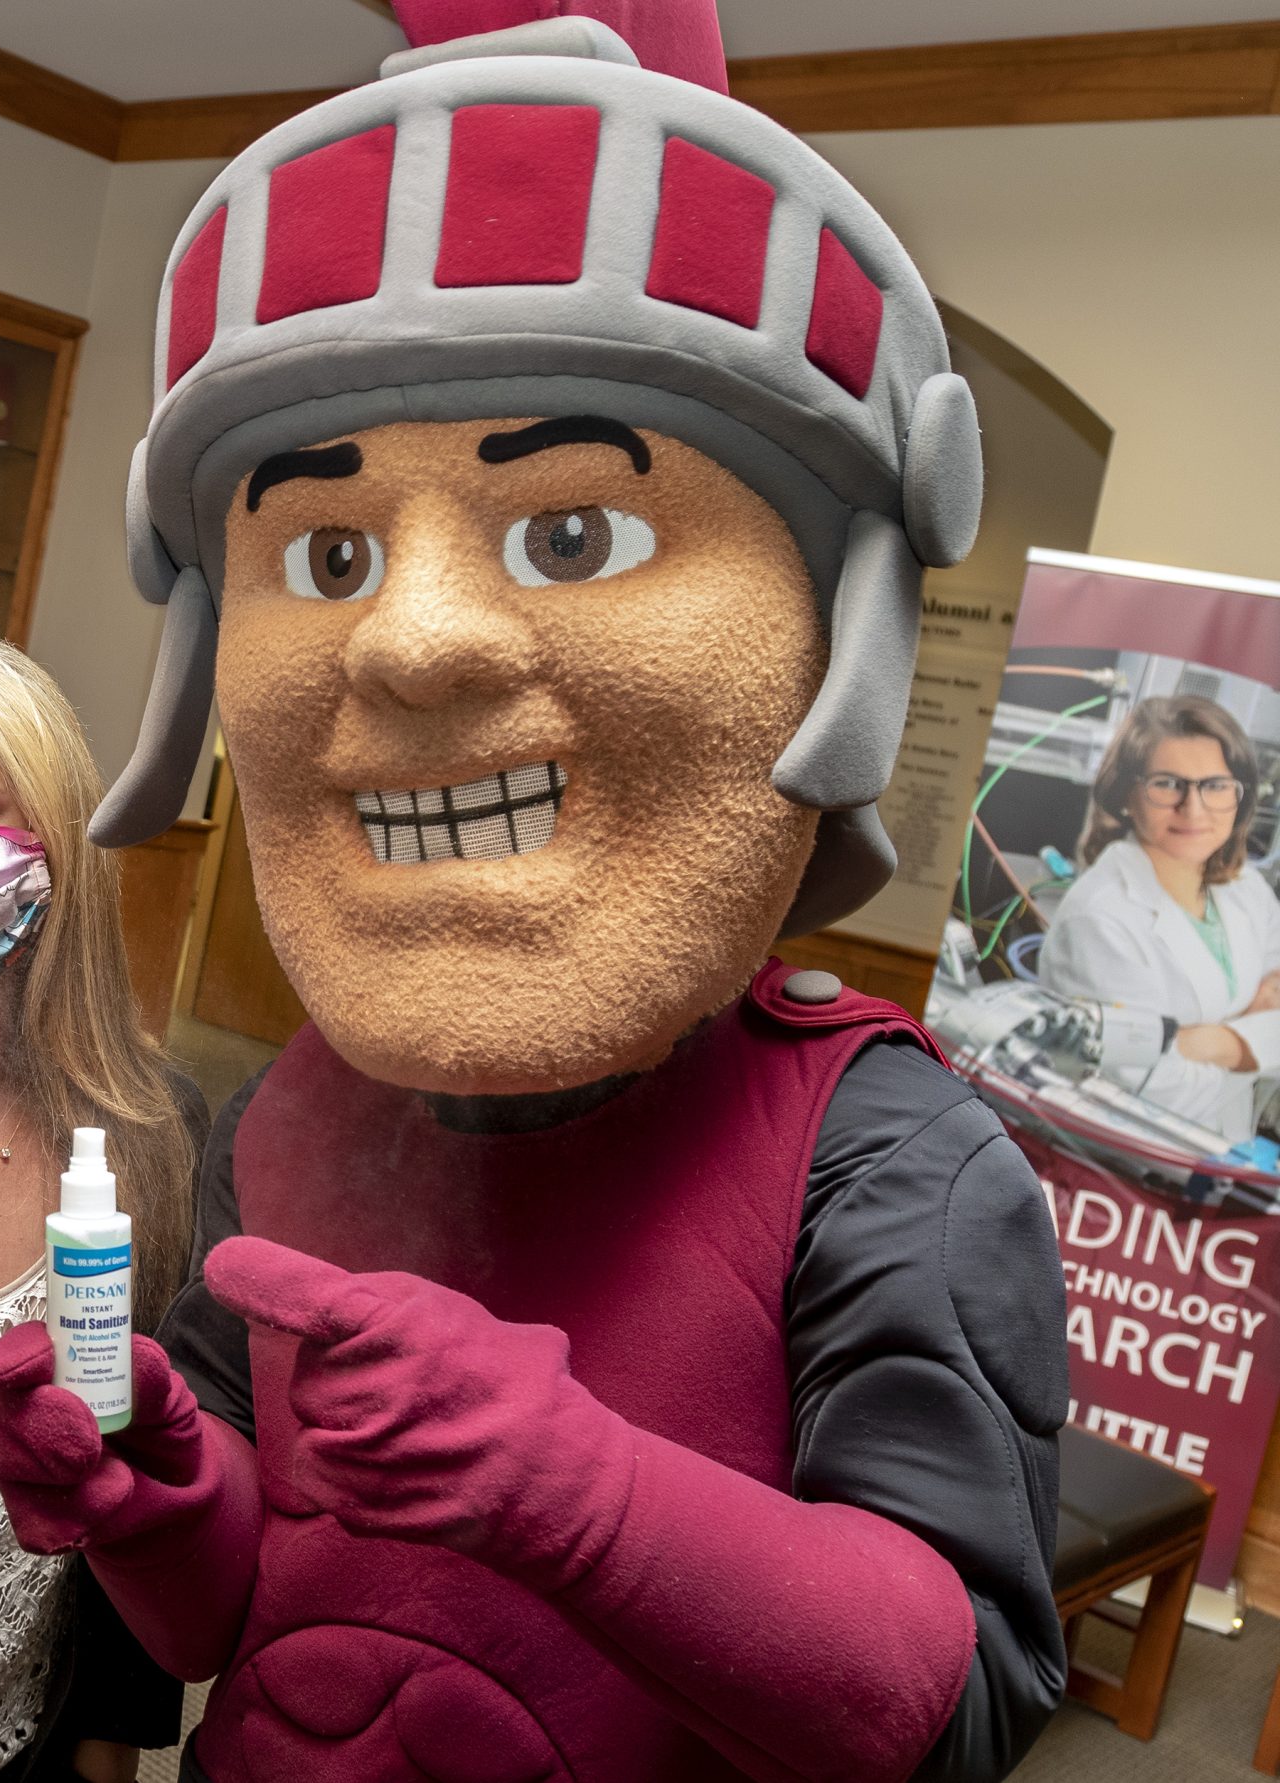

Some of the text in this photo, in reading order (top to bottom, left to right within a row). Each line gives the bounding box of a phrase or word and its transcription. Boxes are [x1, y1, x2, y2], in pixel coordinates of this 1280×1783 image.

[63, 1257, 77, 1267] Kills
[78, 1258, 103, 1267] 99.99%
[104, 1257, 111, 1266] of
[82, 1305, 113, 1313] INSTANT
[60, 1314, 129, 1330] Hand Sanitizer
[73, 1333, 87, 1342] Ethyl
[89, 1333, 109, 1341] Alcohol
[90, 1402, 96, 1410] FL
[98, 1401, 105, 1409] OZ
